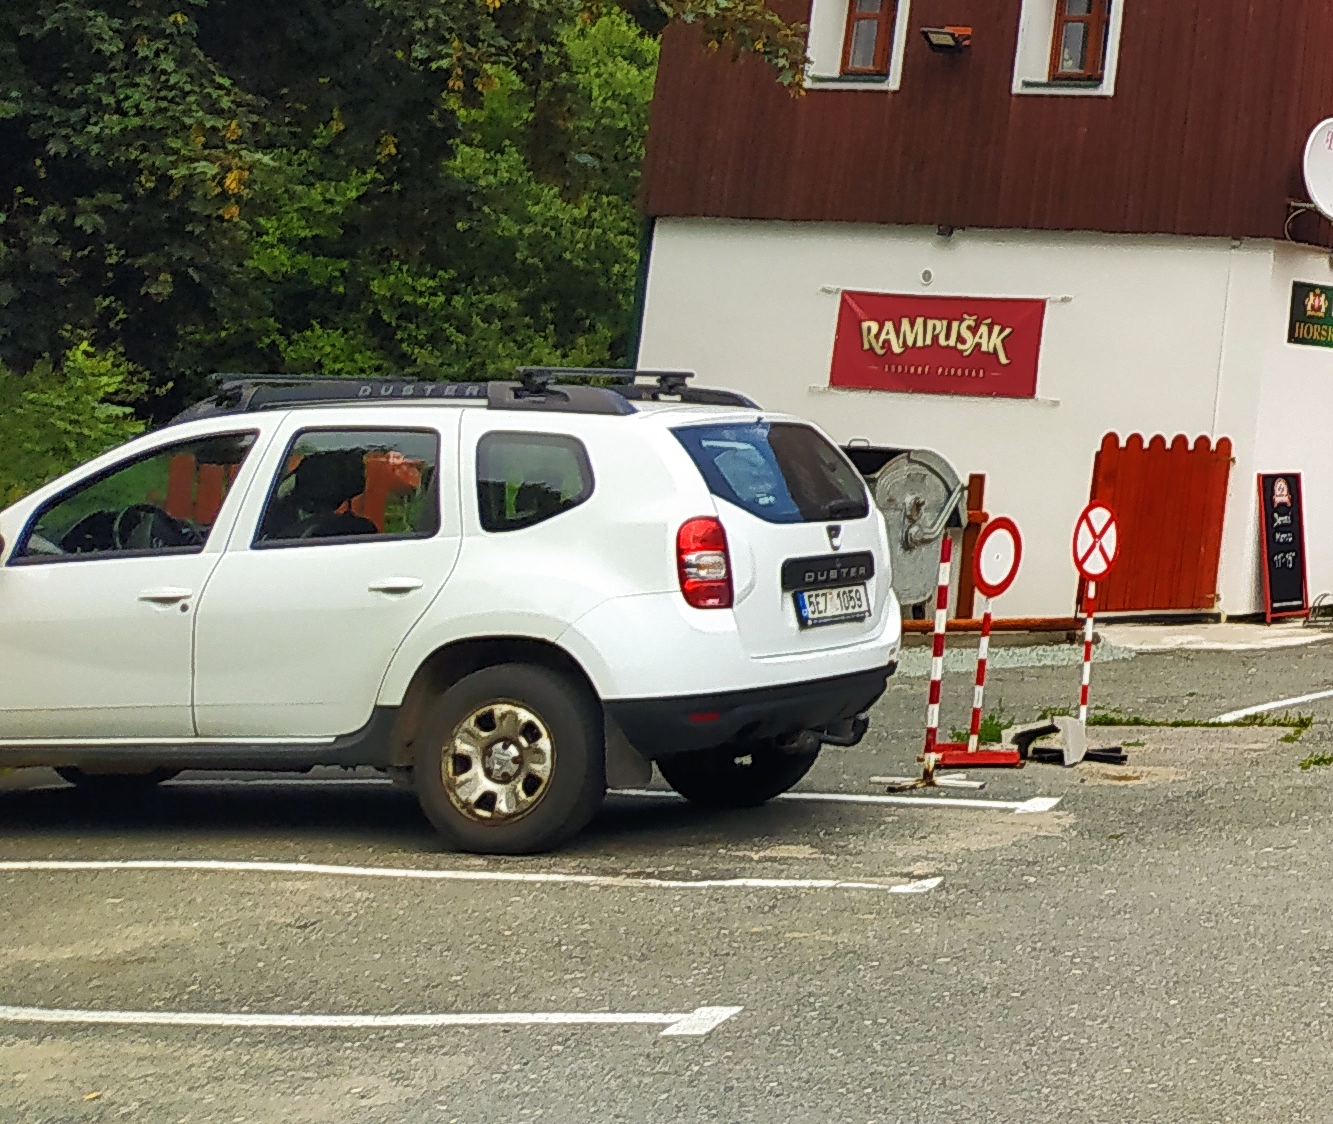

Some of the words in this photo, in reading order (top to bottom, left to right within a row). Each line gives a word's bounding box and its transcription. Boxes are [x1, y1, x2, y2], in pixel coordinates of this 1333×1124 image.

[860, 314, 1013, 365] RAMPUŠÁK
[358, 384, 480, 397] DUSTER
[804, 566, 866, 582] DUSTER
[808, 593, 828, 615] 5E7
[837, 589, 863, 611] 1059
